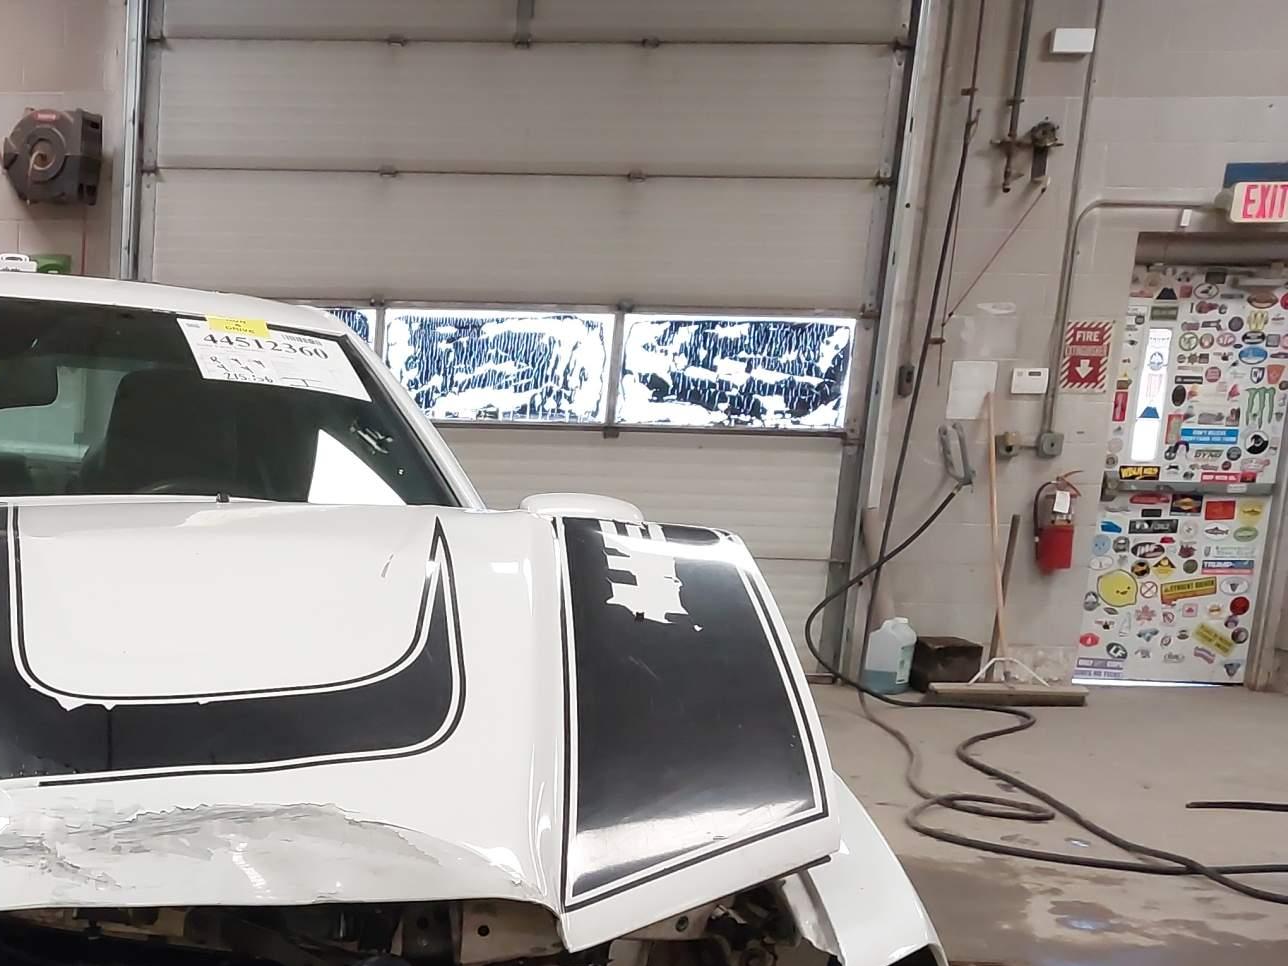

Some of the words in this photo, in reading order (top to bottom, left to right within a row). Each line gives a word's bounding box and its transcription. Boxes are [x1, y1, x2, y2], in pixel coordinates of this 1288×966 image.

[1242, 184, 1288, 218] EXIT
[203, 333, 330, 360] 44512360
[1075, 330, 1100, 342] FIRE
